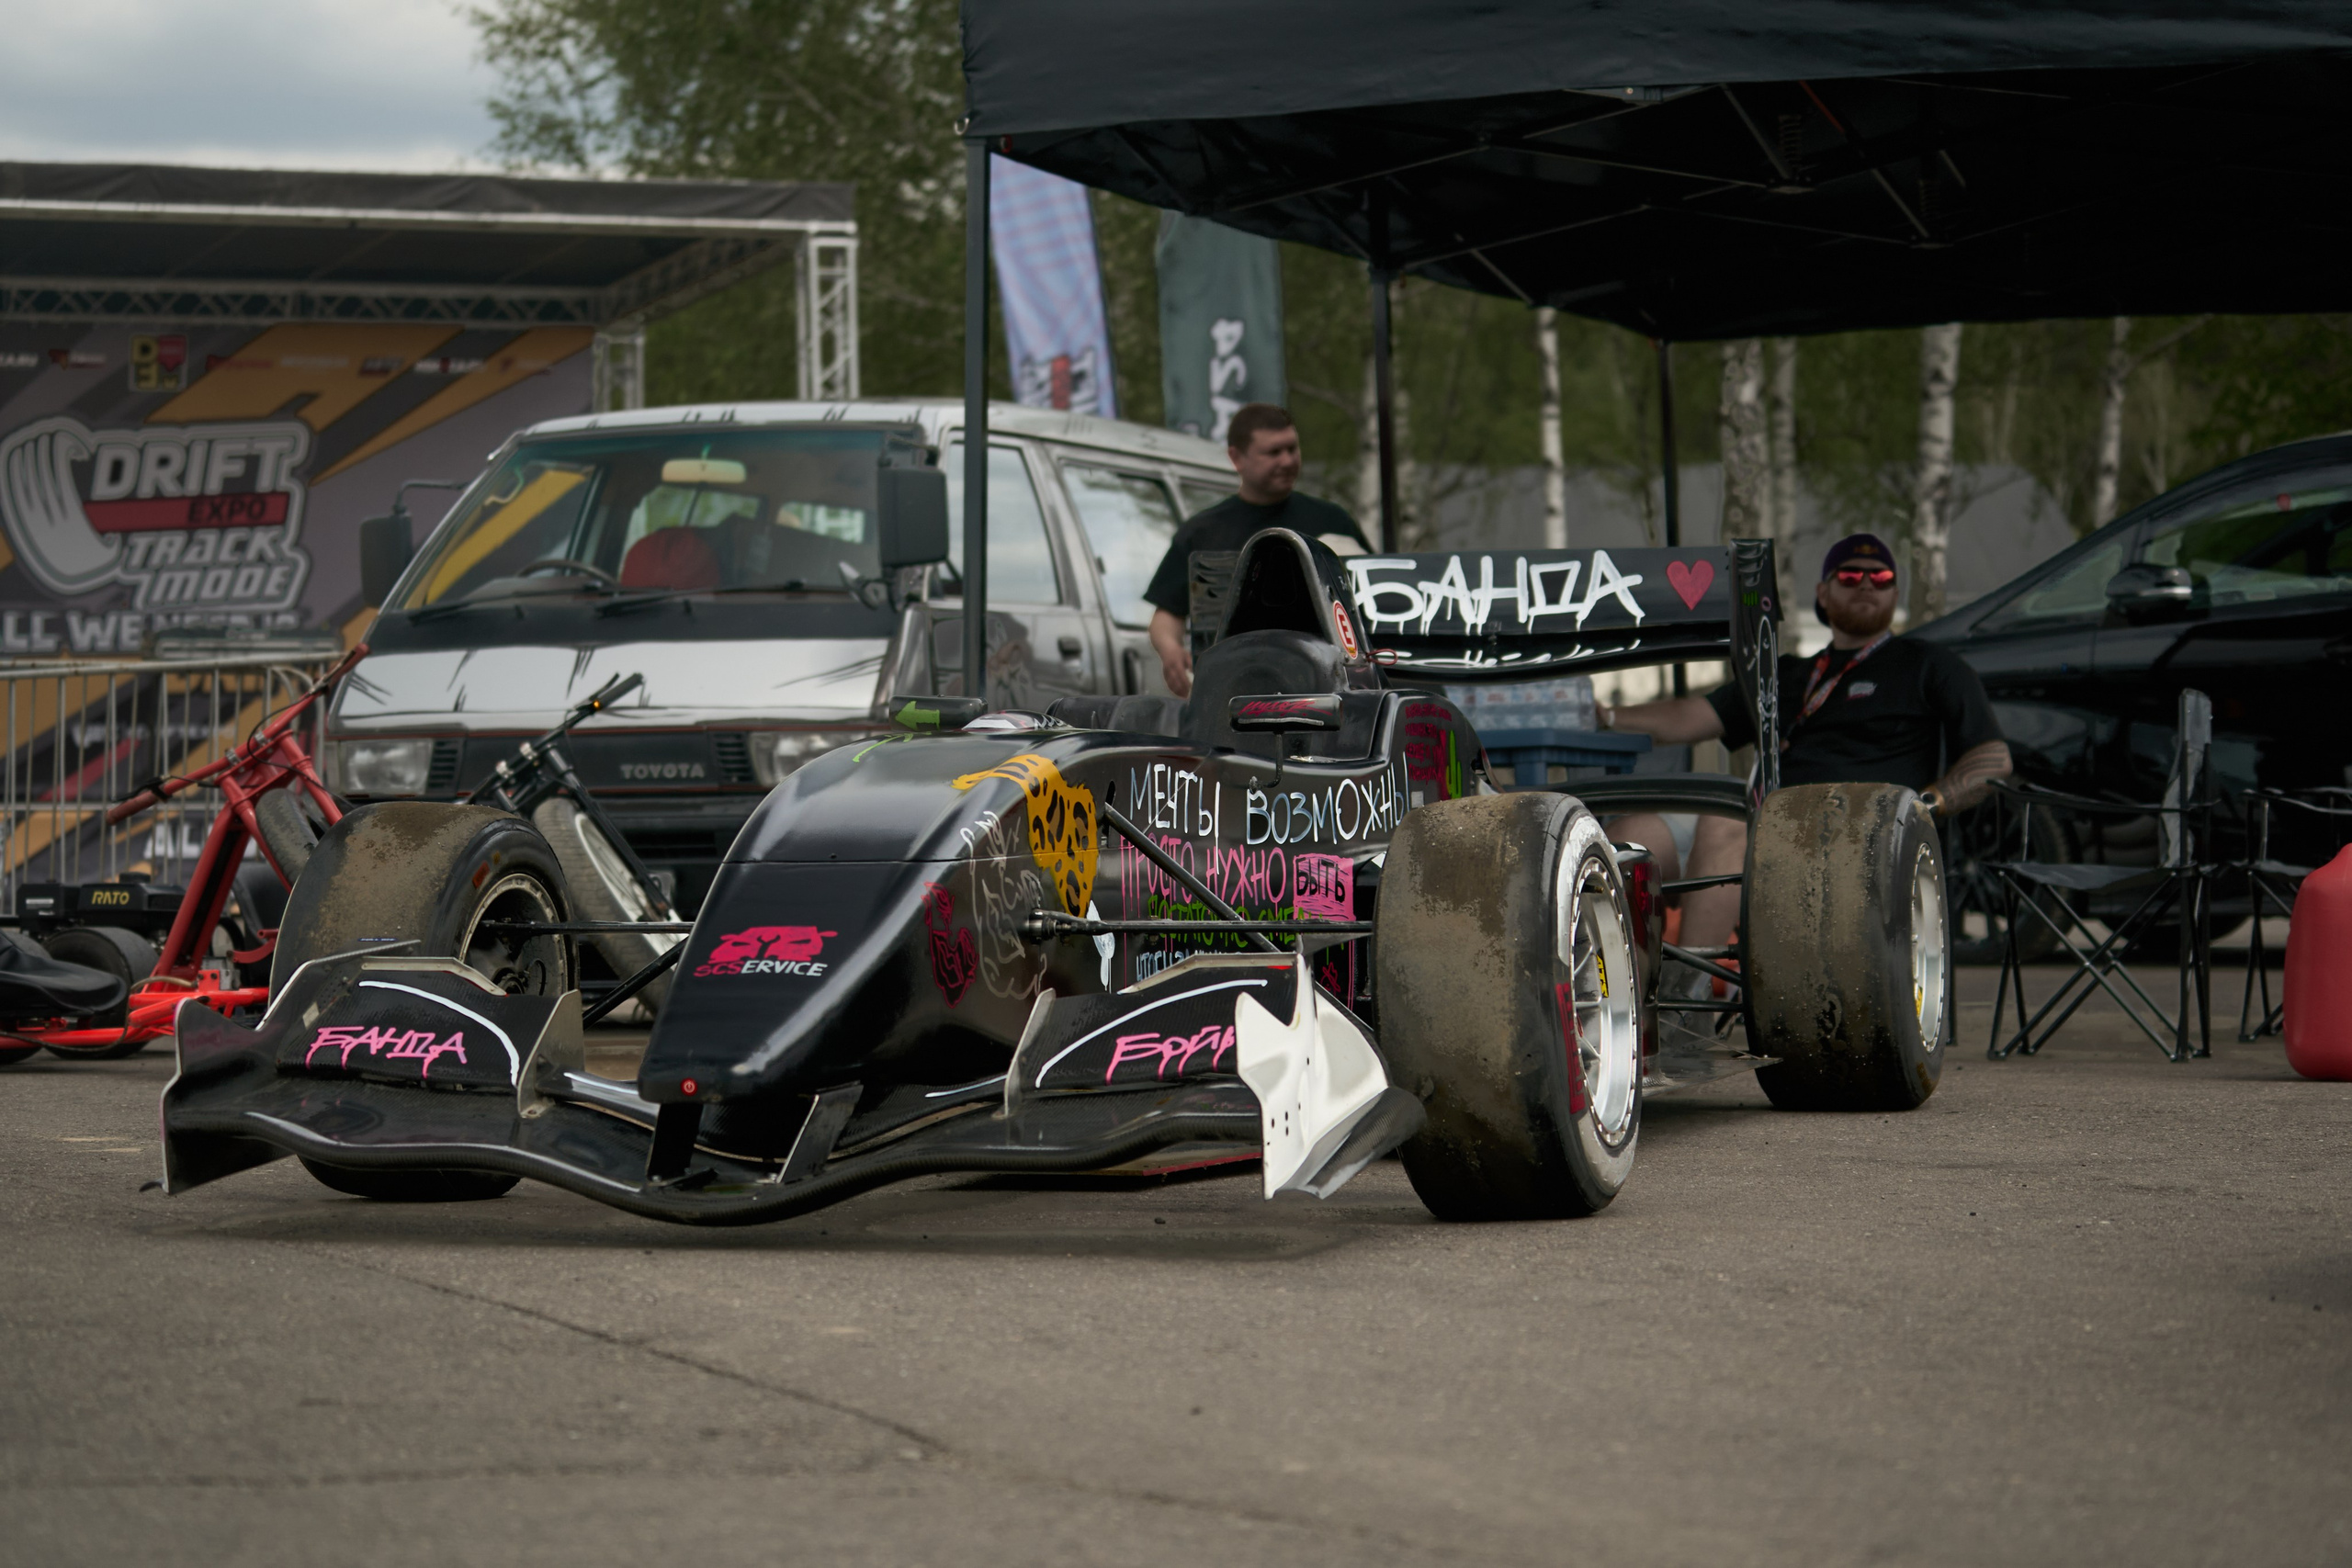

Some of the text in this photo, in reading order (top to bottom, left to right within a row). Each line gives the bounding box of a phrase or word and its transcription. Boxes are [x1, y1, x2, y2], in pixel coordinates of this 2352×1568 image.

[93, 437, 291, 500] DRIFT
[188, 497, 266, 524] EXPO
[126, 529, 282, 567] TRACK
[148, 565, 290, 603] MODE
[1346, 550, 1645, 635] БАНДА
[66, 610, 142, 651] WE
[1338, 615, 1352, 645] E
[619, 762, 706, 779] TOYOTA
[1130, 750, 1410, 845] МЕЧТЫ ВОЗМОЖНЫ
[1205, 843, 1286, 907] НУЖНО
[1295, 858, 1346, 903] БЫТЬ
[92, 891, 130, 905] RATO
[305, 1025, 468, 1079] БАНДА
